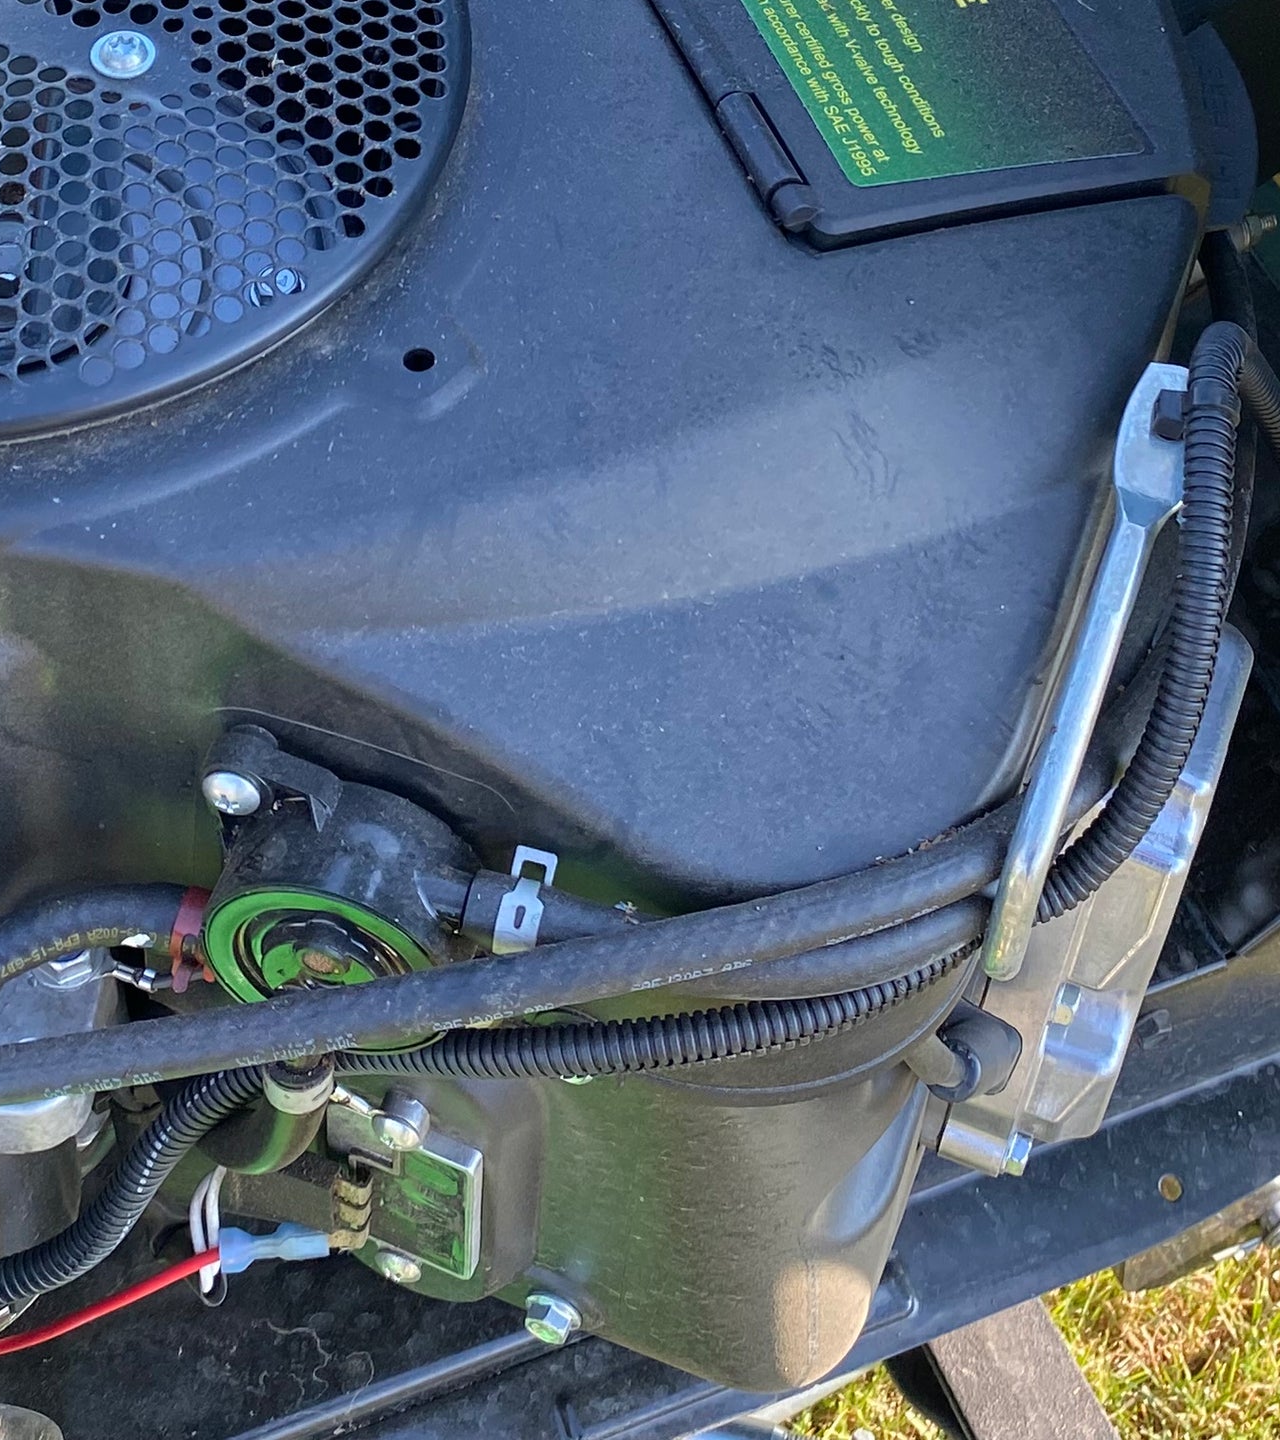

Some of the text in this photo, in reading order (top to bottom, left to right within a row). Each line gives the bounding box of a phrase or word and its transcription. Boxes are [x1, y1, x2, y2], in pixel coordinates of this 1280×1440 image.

[763, 7, 811, 75] accordance
[806, 77, 831, 103] with
[824, 105, 851, 135] SAE
[842, 137, 877, 177] J1995
[795, 21, 834, 68] certified
[822, 71, 852, 105] gross
[844, 107, 880, 146] power
[872, 148, 891, 163] at
[826, 12, 850, 38] with
[845, 38, 878, 85] V-valve
[873, 86, 923, 154] technology
[866, 23, 880, 37] to
[875, 38, 905, 73] tough
[899, 75, 945, 138] conditions
[891, 13, 923, 53] design
